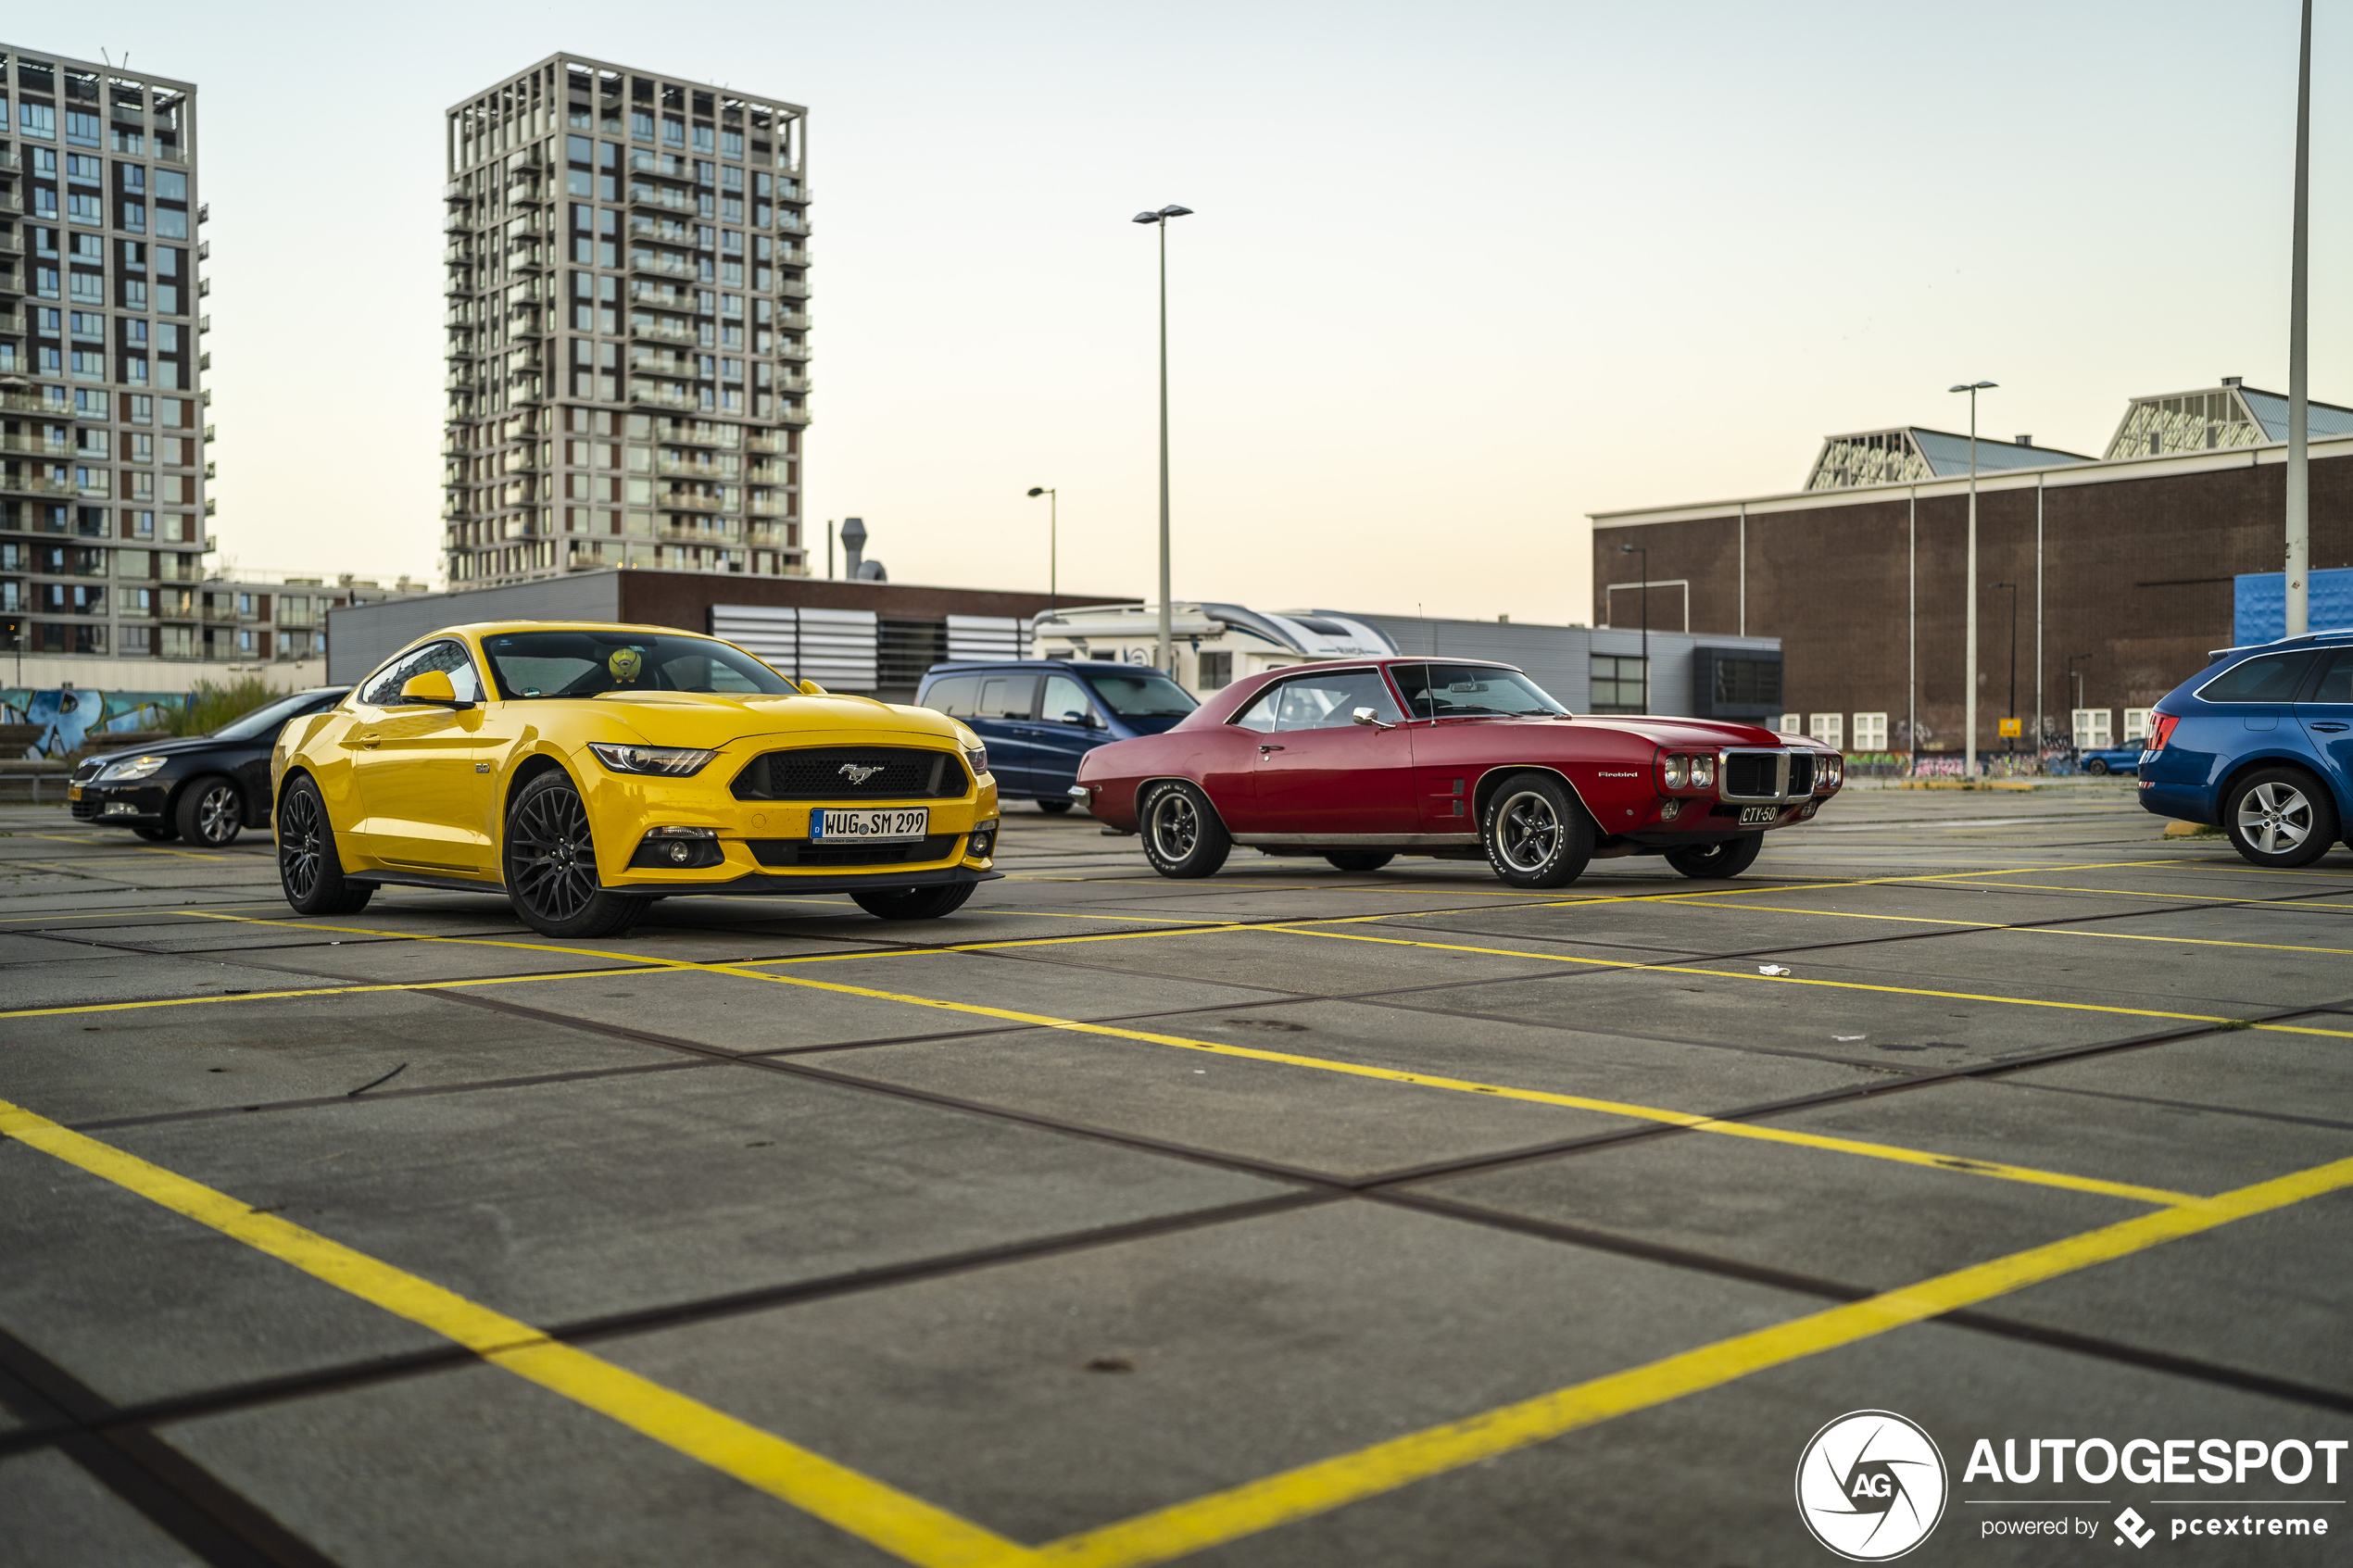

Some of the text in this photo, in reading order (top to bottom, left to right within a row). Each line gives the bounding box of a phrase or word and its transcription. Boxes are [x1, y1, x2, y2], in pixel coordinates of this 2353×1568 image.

[1148, 784, 1172, 809] RADIAL
[824, 812, 925, 834] WUG SM 299
[1147, 847, 1176, 870] GALAXY
[1486, 833, 1506, 873] RADIAL
[1541, 824, 1564, 875] GALAXY
